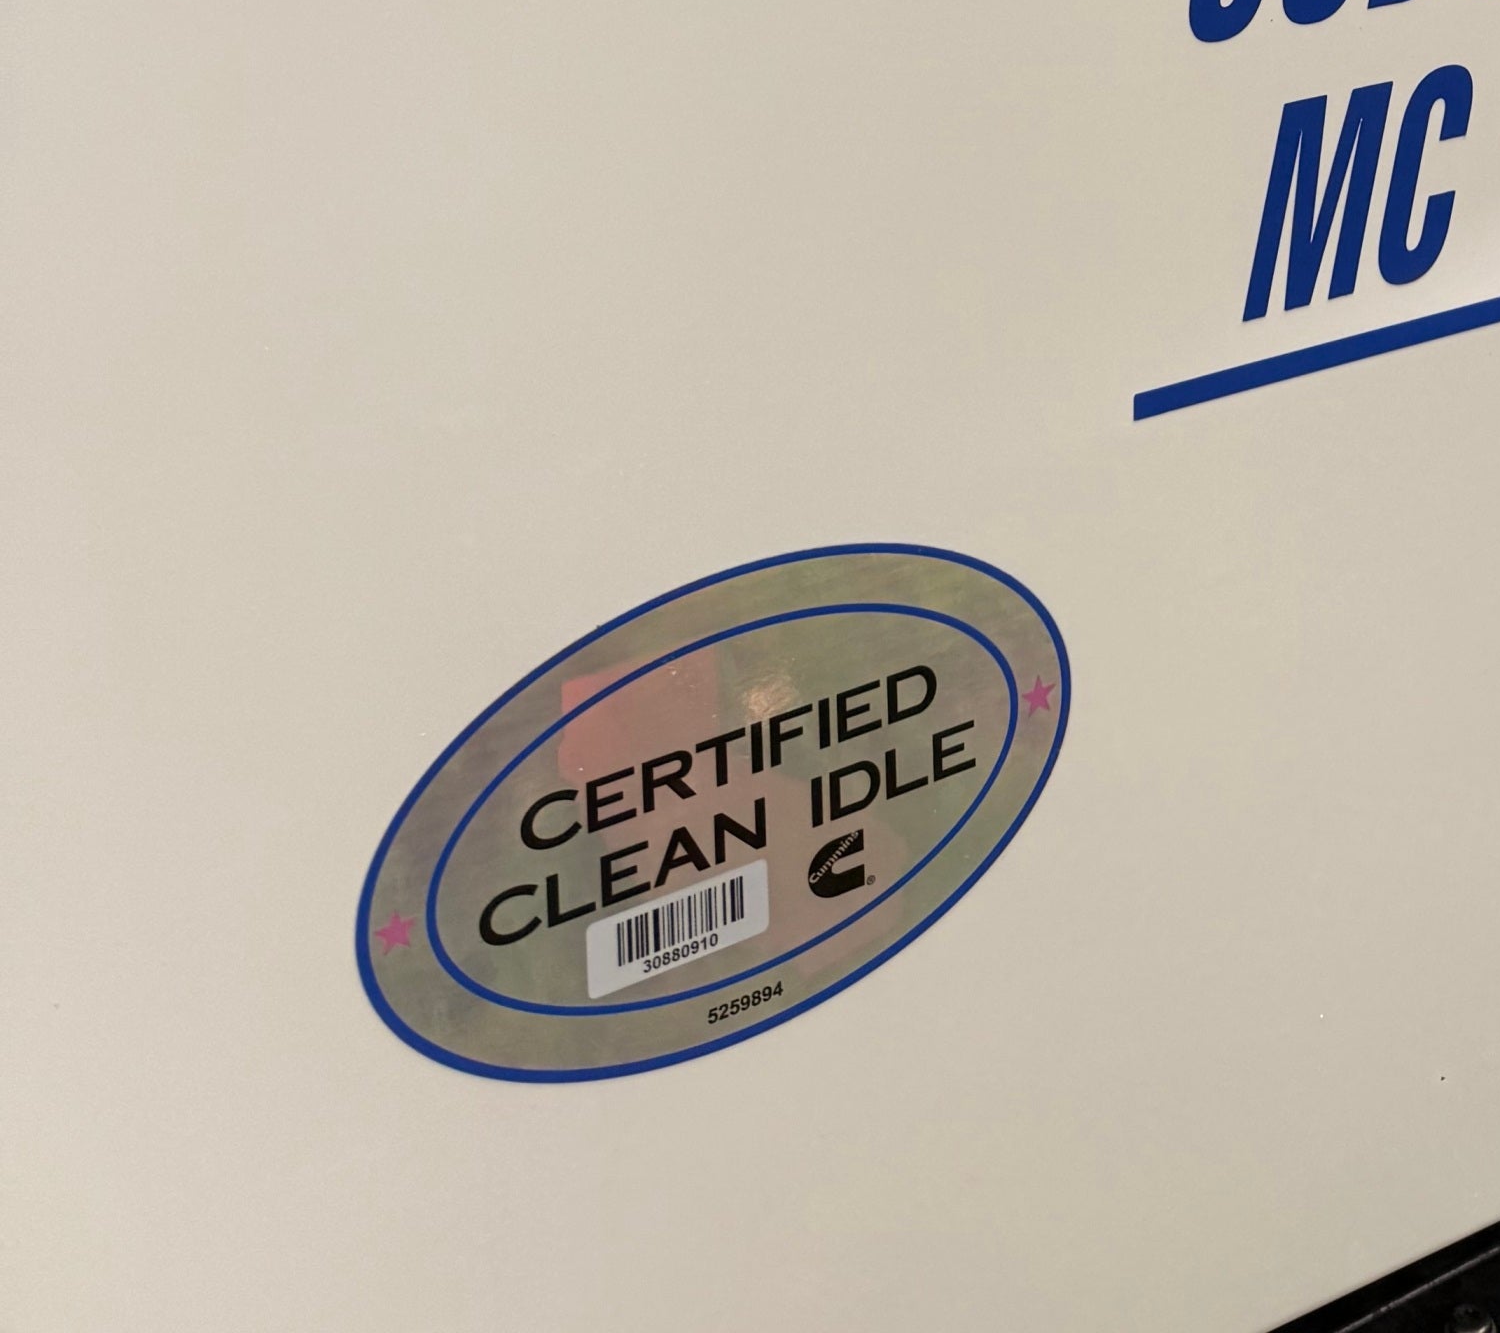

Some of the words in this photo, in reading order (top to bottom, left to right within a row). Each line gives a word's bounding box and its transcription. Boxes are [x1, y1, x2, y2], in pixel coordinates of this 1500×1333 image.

[1242, 64, 1473, 322] MC
[519, 664, 936, 850] CERTIFIED
[478, 798, 767, 946] CLEAN
[810, 720, 976, 827] IDLE
[809, 831, 860, 884] Cummins
[643, 933, 718, 973] 30880910
[707, 981, 784, 1025] 5259894
